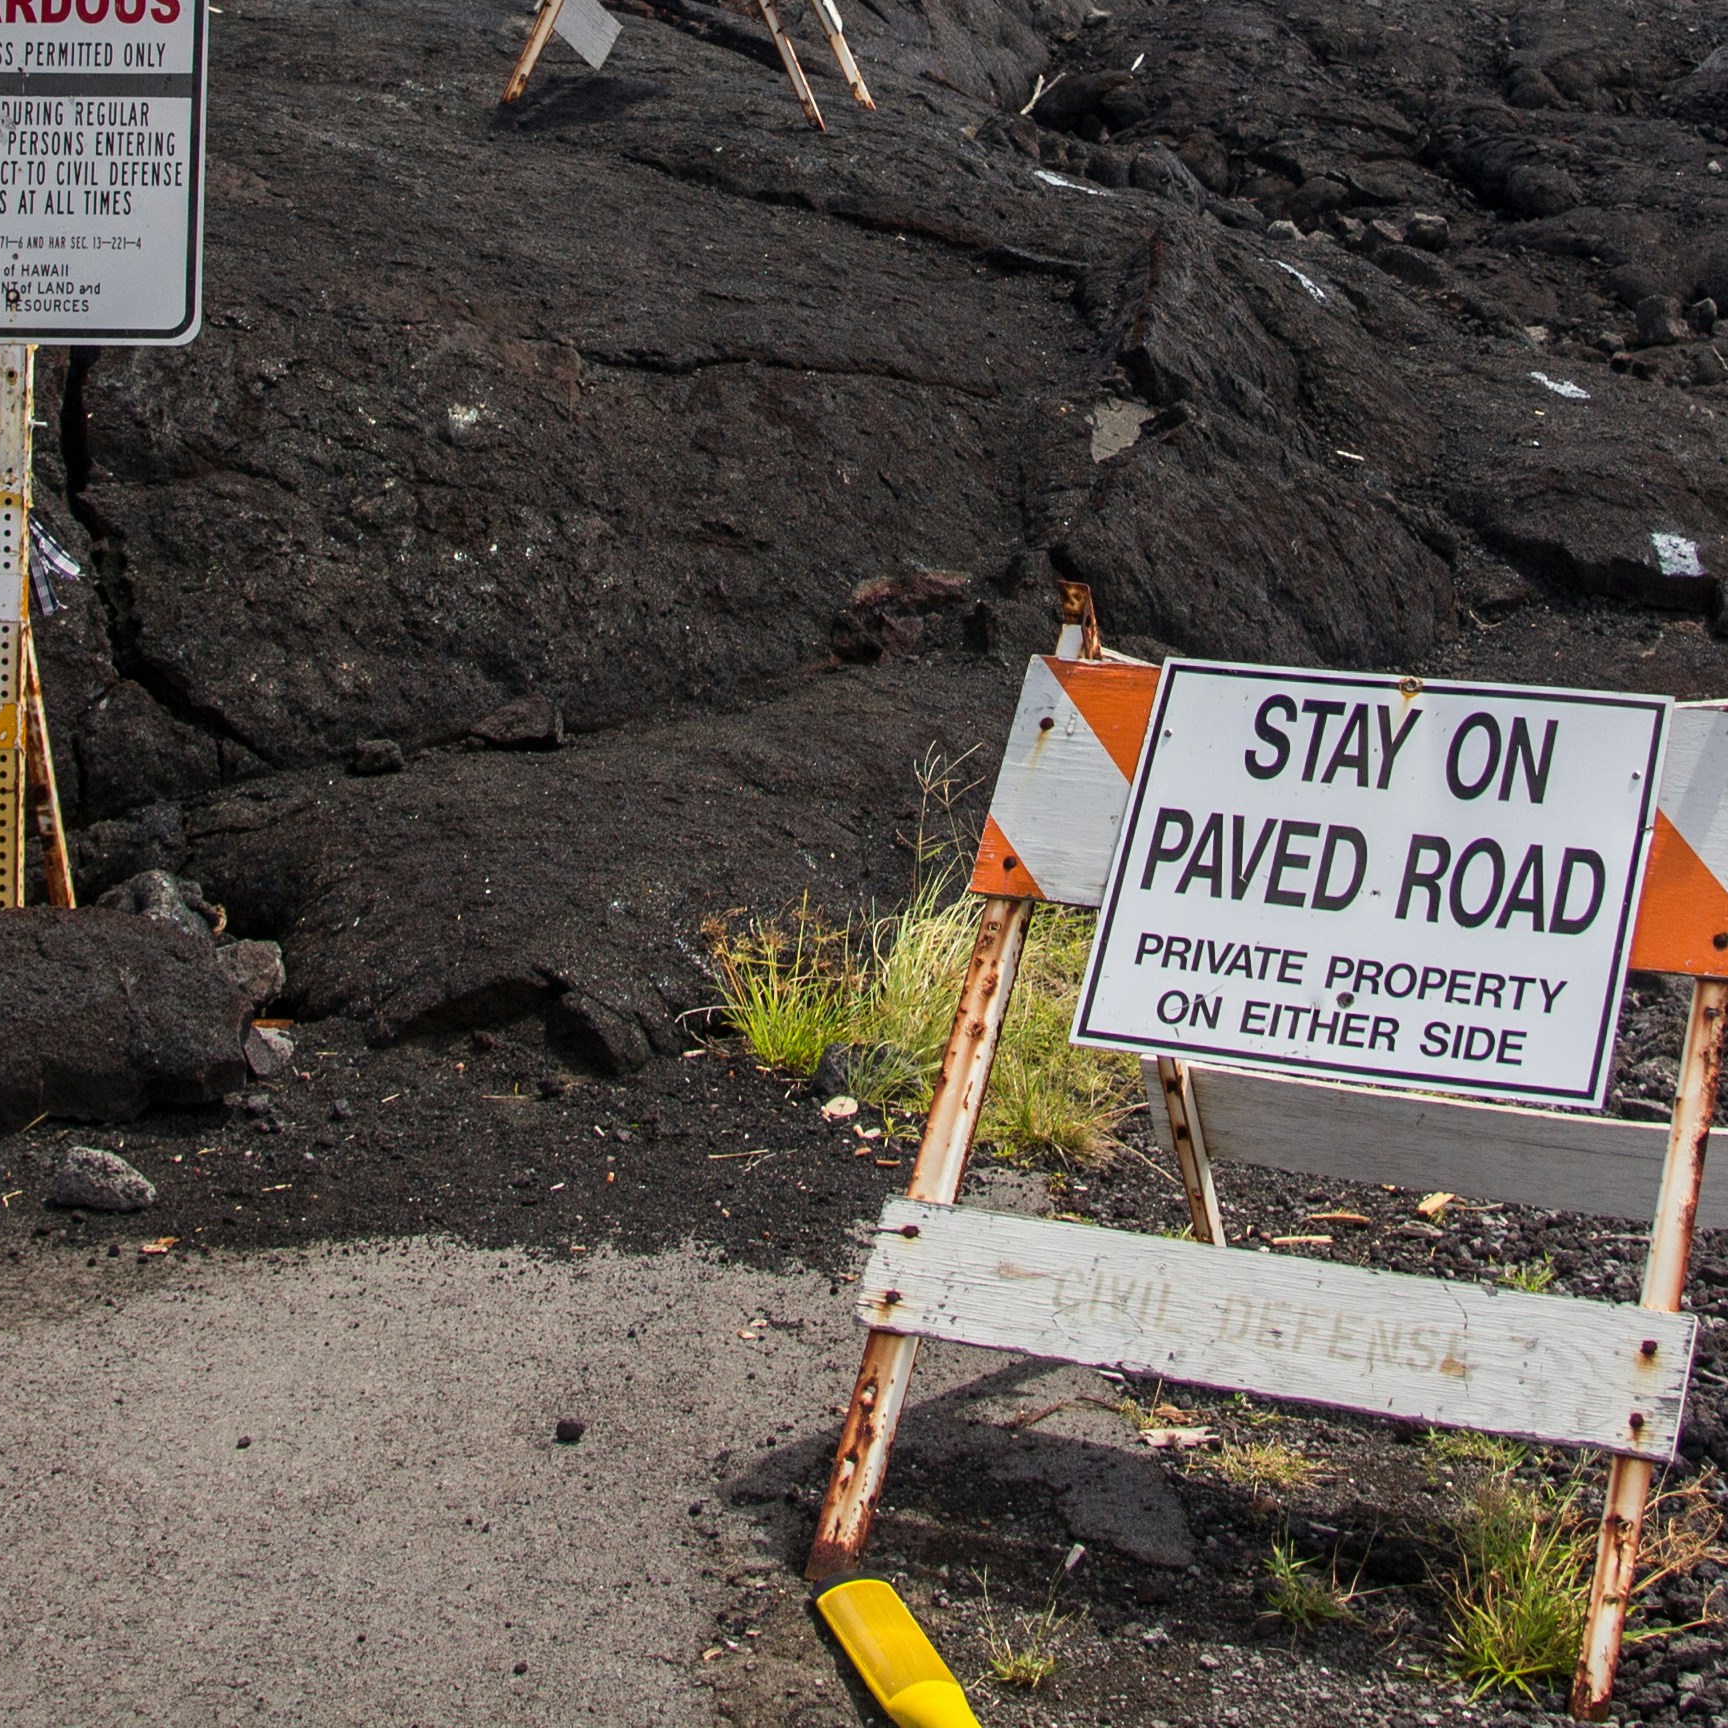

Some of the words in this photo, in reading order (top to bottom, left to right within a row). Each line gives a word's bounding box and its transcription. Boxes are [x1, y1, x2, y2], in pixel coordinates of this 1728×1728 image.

[25, 42, 113, 67] PERMITTED
[124, 43, 166, 67] ONLY
[1, 101, 64, 126] DURING
[75, 101, 149, 126] REGULAR
[7, 131, 84, 156] PERSONS
[95, 132, 175, 156] ENTERING
[27, 161, 45, 185] TO
[56, 161, 98, 186] CIVIL
[110, 162, 183, 186] DEFENSE
[18, 190, 36, 214] AT
[45, 190, 74, 215] ALL
[84, 190, 132, 215] TIMES
[27, 236, 44, 249] AND
[49, 236, 66, 249] HAR
[71, 236, 89, 249] SEC.
[4, 263, 15, 276] of
[21, 264, 69, 277] HAWAII
[20, 281, 33, 294] of
[37, 282, 73, 295] LAND
[79, 282, 101, 295] and
[5, 299, 89, 312] RESOURCES
[1244, 693, 1424, 790] STAY
[1446, 711, 1559, 804] ON
[1140, 807, 1368, 911] PAVED
[1394, 833, 1606, 935] ROAD
[1134, 933, 1308, 985] PRIVATE
[1325, 955, 1568, 1014] PROPERTY
[1156, 990, 1223, 1030] ON
[1240, 1000, 1400, 1052] EITHER
[1420, 1021, 1528, 1066] SIDE
[1052, 1266, 1183, 1334] CIVIL
